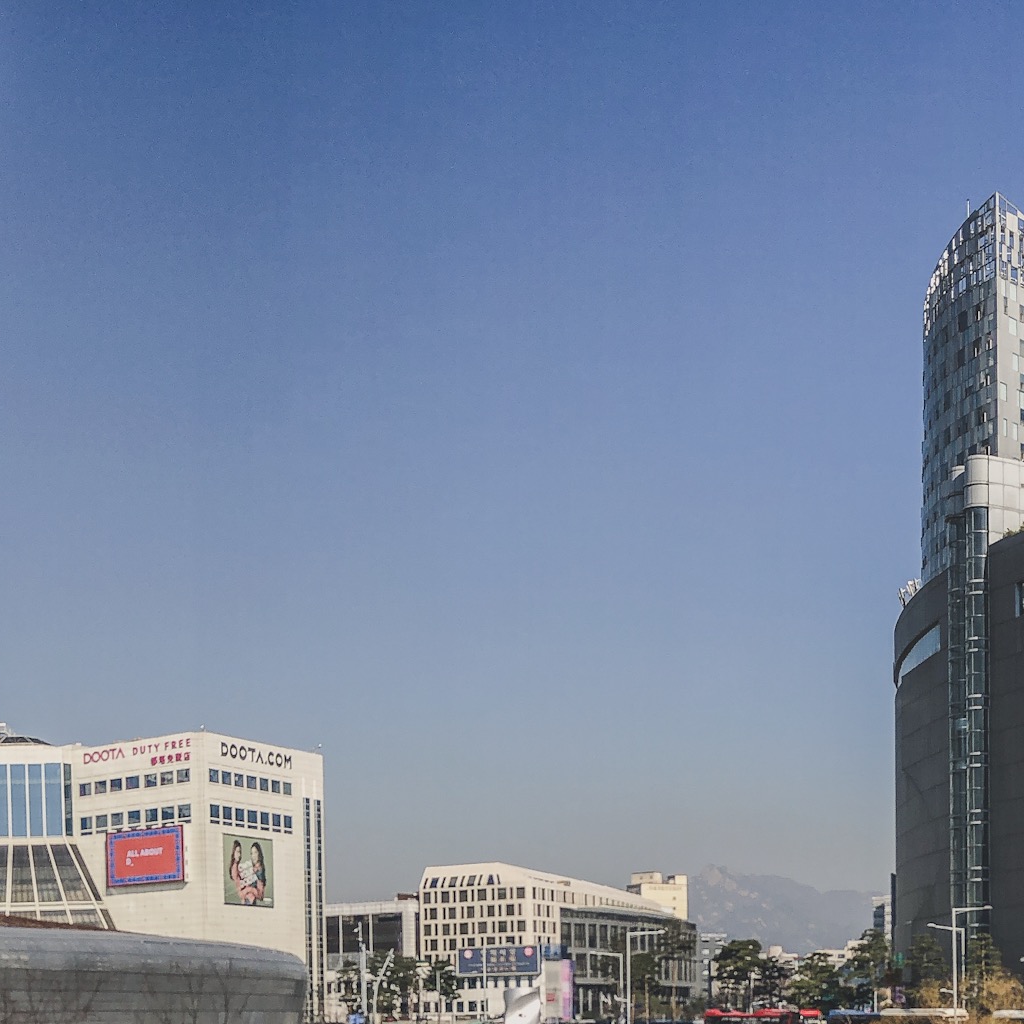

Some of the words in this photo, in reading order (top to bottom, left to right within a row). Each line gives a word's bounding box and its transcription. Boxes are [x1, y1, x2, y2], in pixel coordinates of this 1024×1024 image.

[83, 747, 125, 765] DOOTA
[132, 742, 160, 756] DUTY
[164, 738, 191, 752] FREE
[220, 741, 293, 770] DOOTA.COM
[126, 849, 139, 858] ALL
[140, 847, 163, 857] ABOUT
